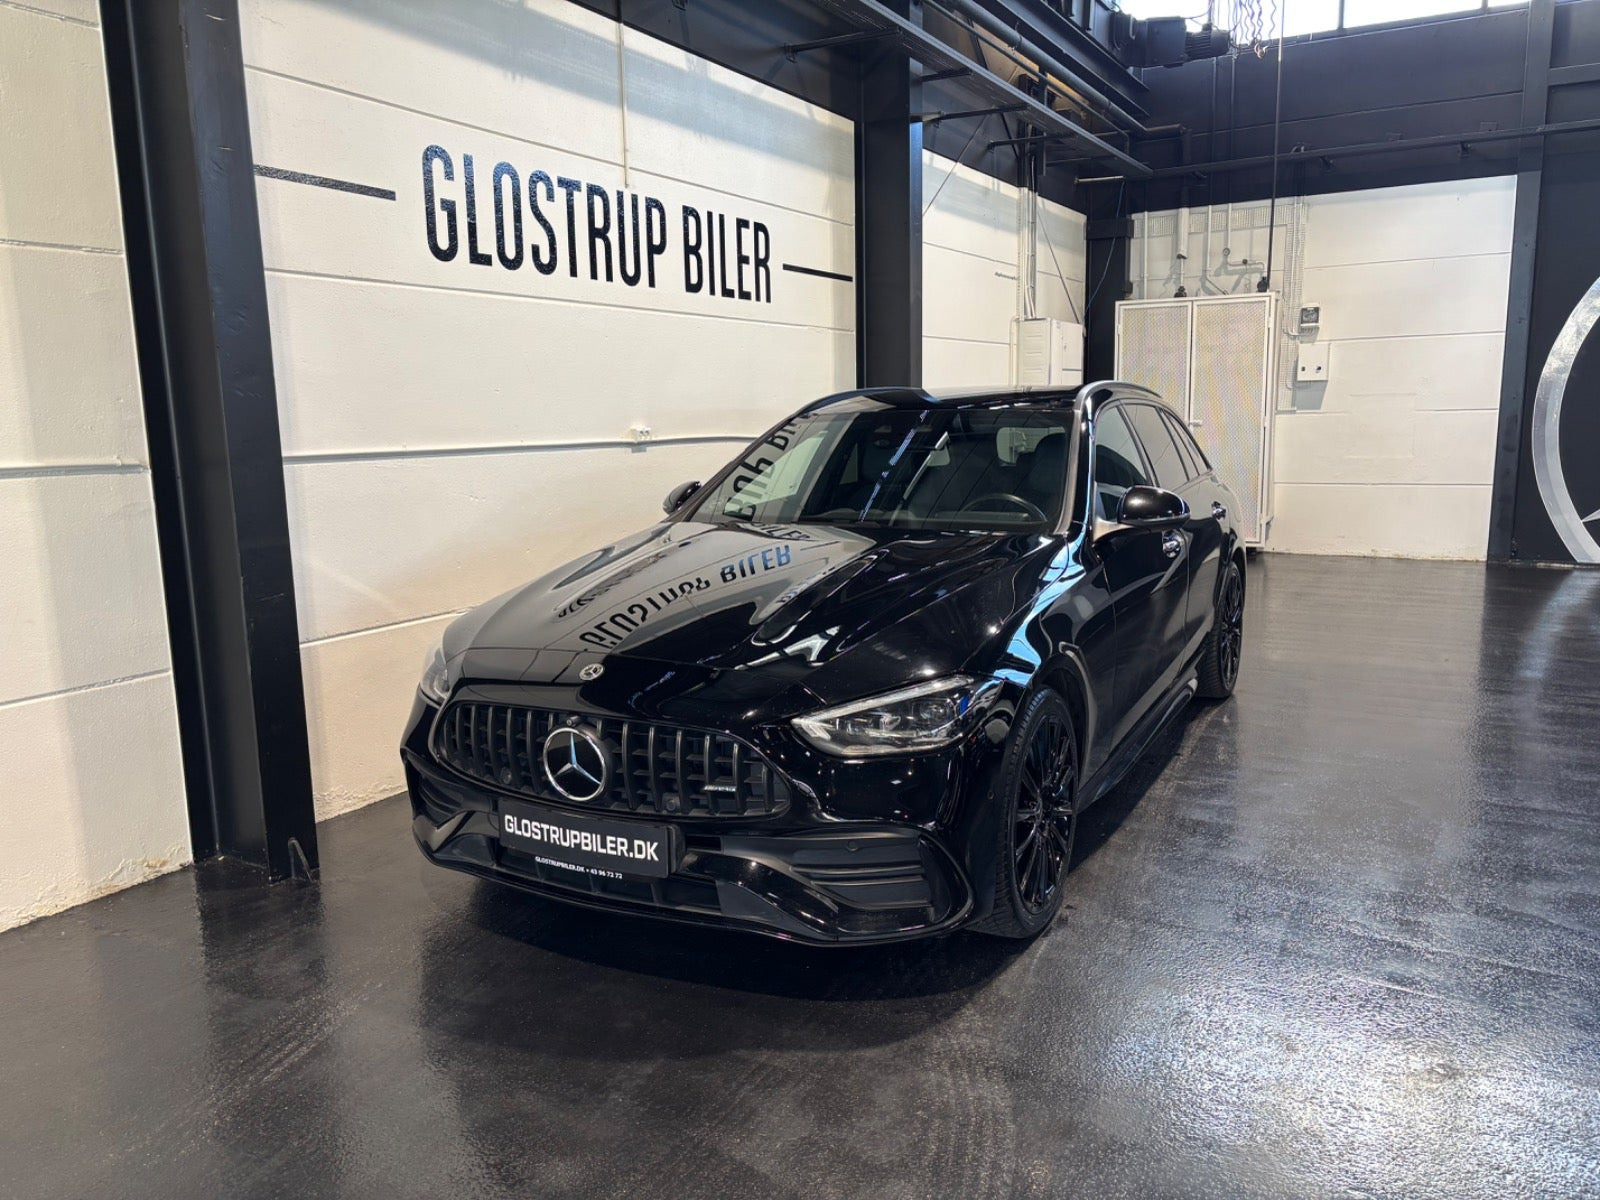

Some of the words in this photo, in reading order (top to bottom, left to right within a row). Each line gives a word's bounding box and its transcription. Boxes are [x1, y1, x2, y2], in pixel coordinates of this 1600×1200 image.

[422, 144, 667, 288] GLOSTRUP
[682, 204, 772, 304] BILER
[504, 814, 659, 862] GLOSTRUPBILER.DK
